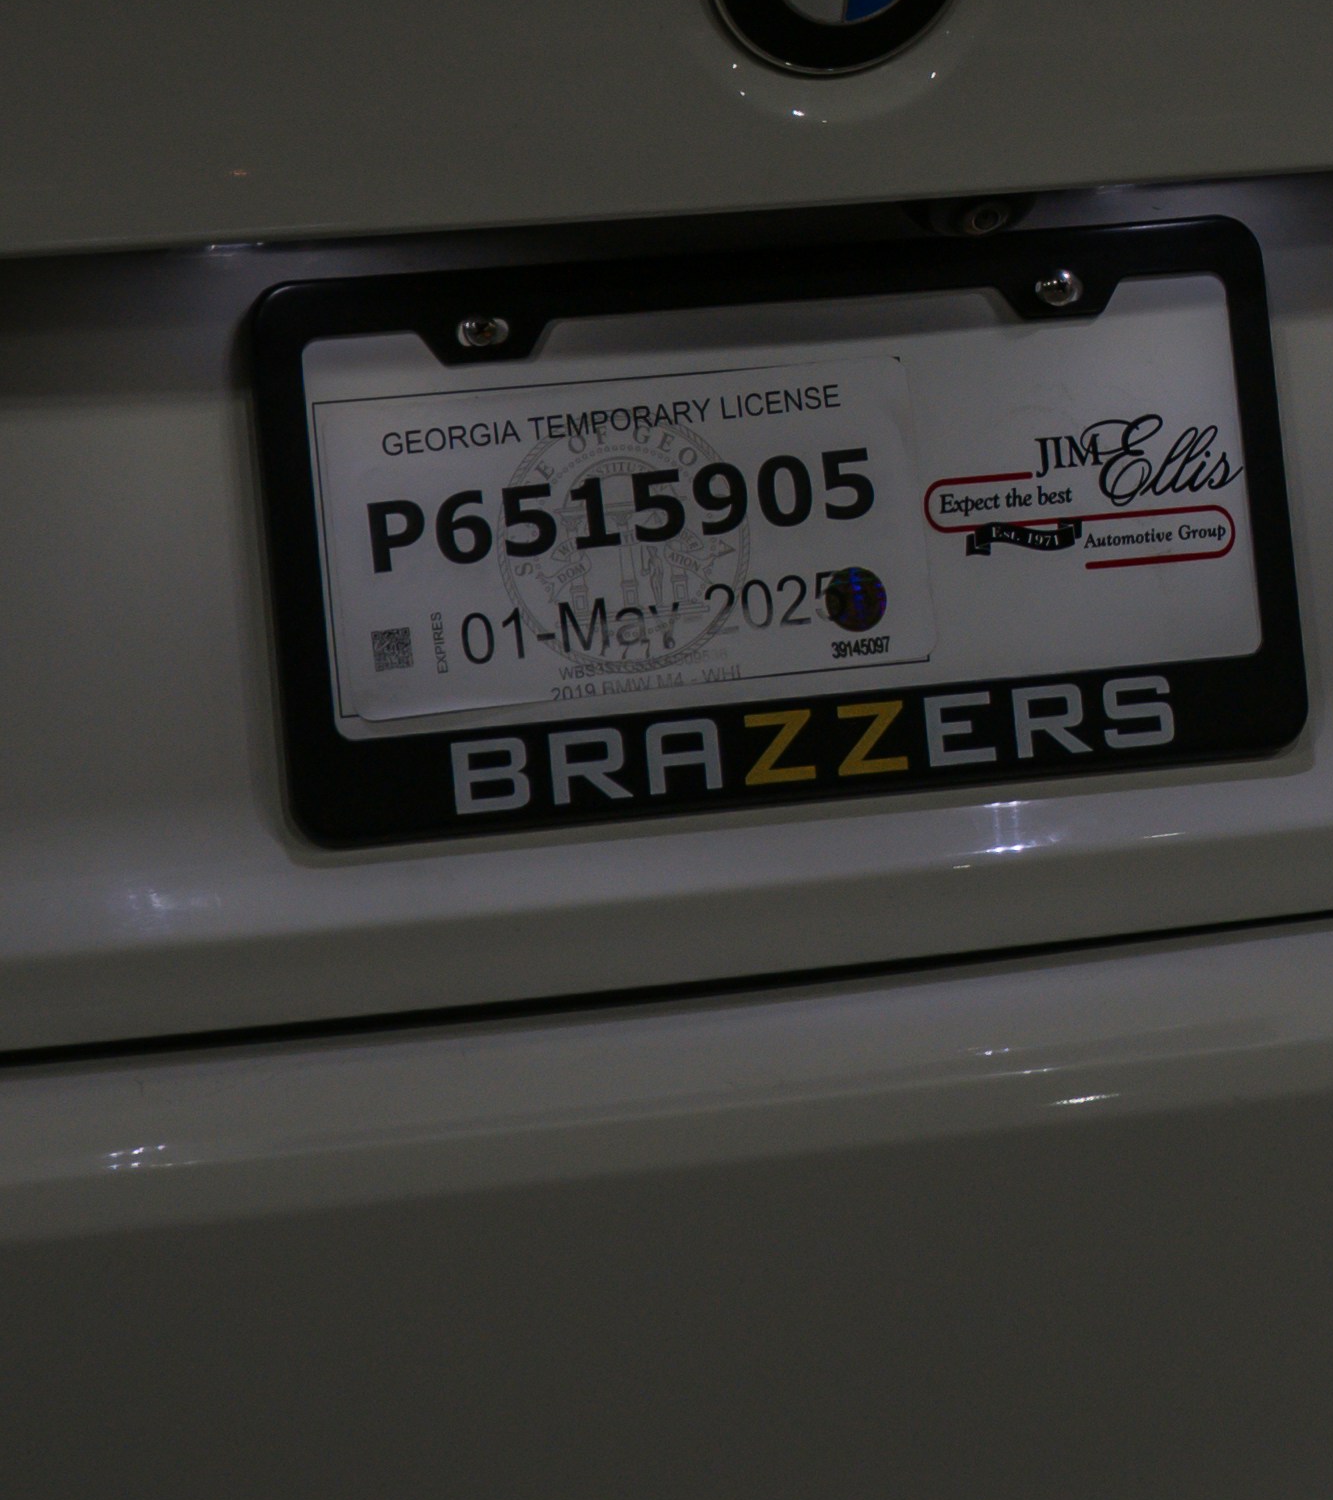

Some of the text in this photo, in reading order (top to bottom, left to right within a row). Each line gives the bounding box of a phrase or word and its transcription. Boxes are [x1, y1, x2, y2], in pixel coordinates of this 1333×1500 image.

[382, 384, 842, 456] GEORGIA TEMPORARY LICENSE
[1035, 413, 1243, 506] JIM Ellis
[367, 447, 875, 574] P6515905
[939, 485, 1073, 516] Expect the best
[1027, 532, 1059, 547] 1971
[1083, 524, 1227, 549] Automotive Group
[430, 611, 449, 674] EXPIRES
[831, 636, 891, 659] 39145097
[551, 682, 597, 700] 2019
[450, 675, 1176, 816] BRAZZERS
